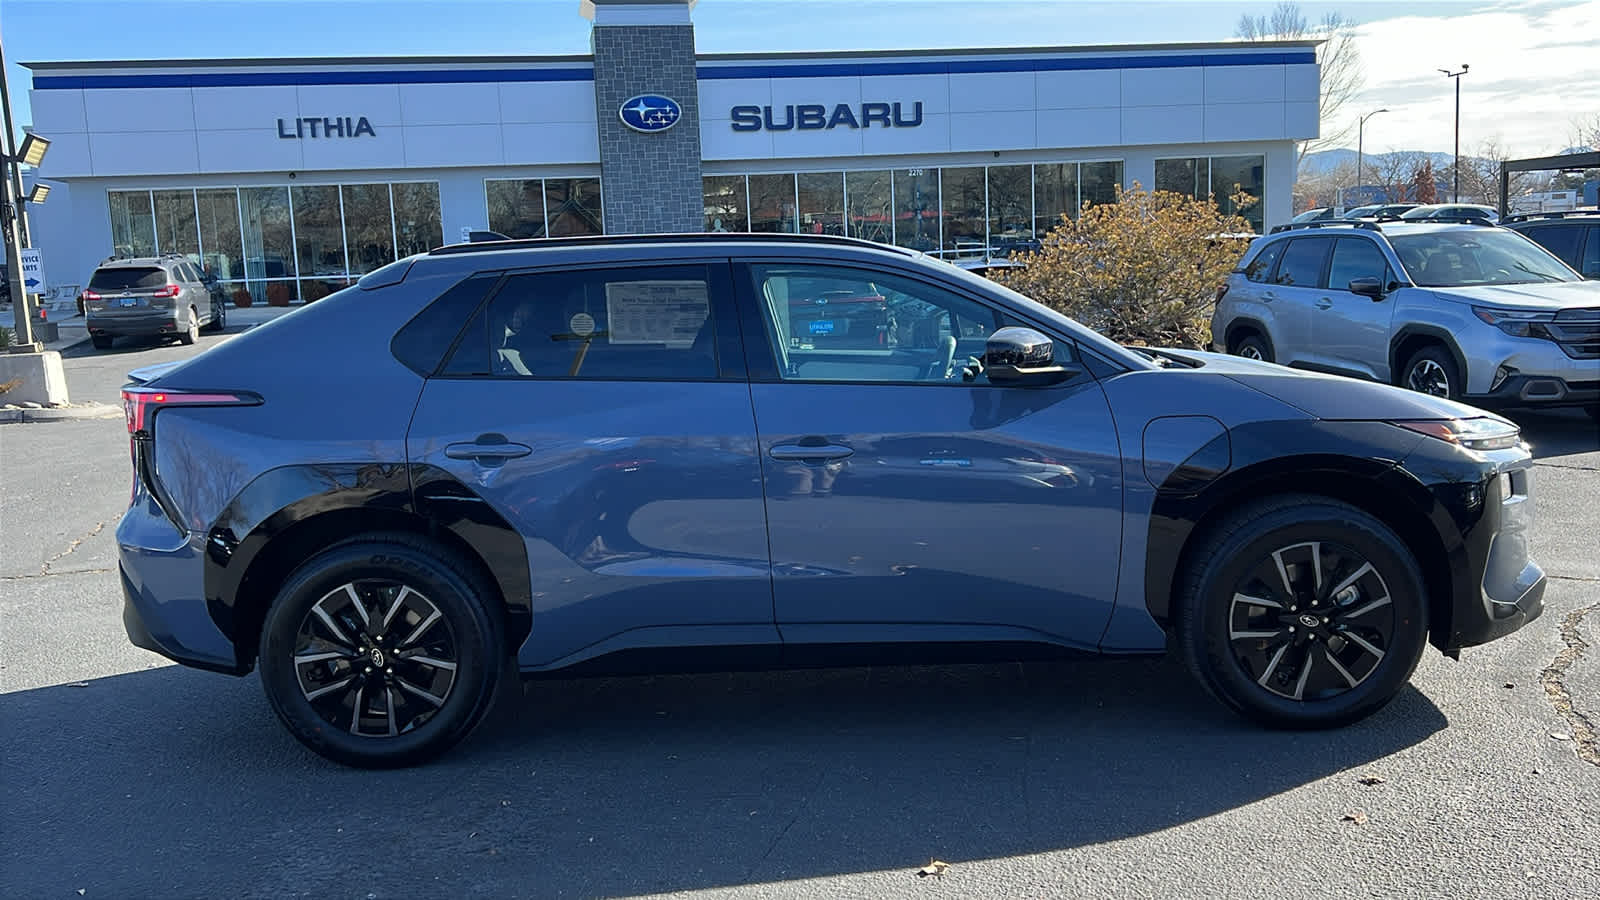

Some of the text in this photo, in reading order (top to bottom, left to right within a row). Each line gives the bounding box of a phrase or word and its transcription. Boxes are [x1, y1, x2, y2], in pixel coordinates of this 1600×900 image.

[731, 101, 923, 131] SUBARU
[277, 117, 376, 139] LITHIA
[908, 168, 923, 176] 2270
